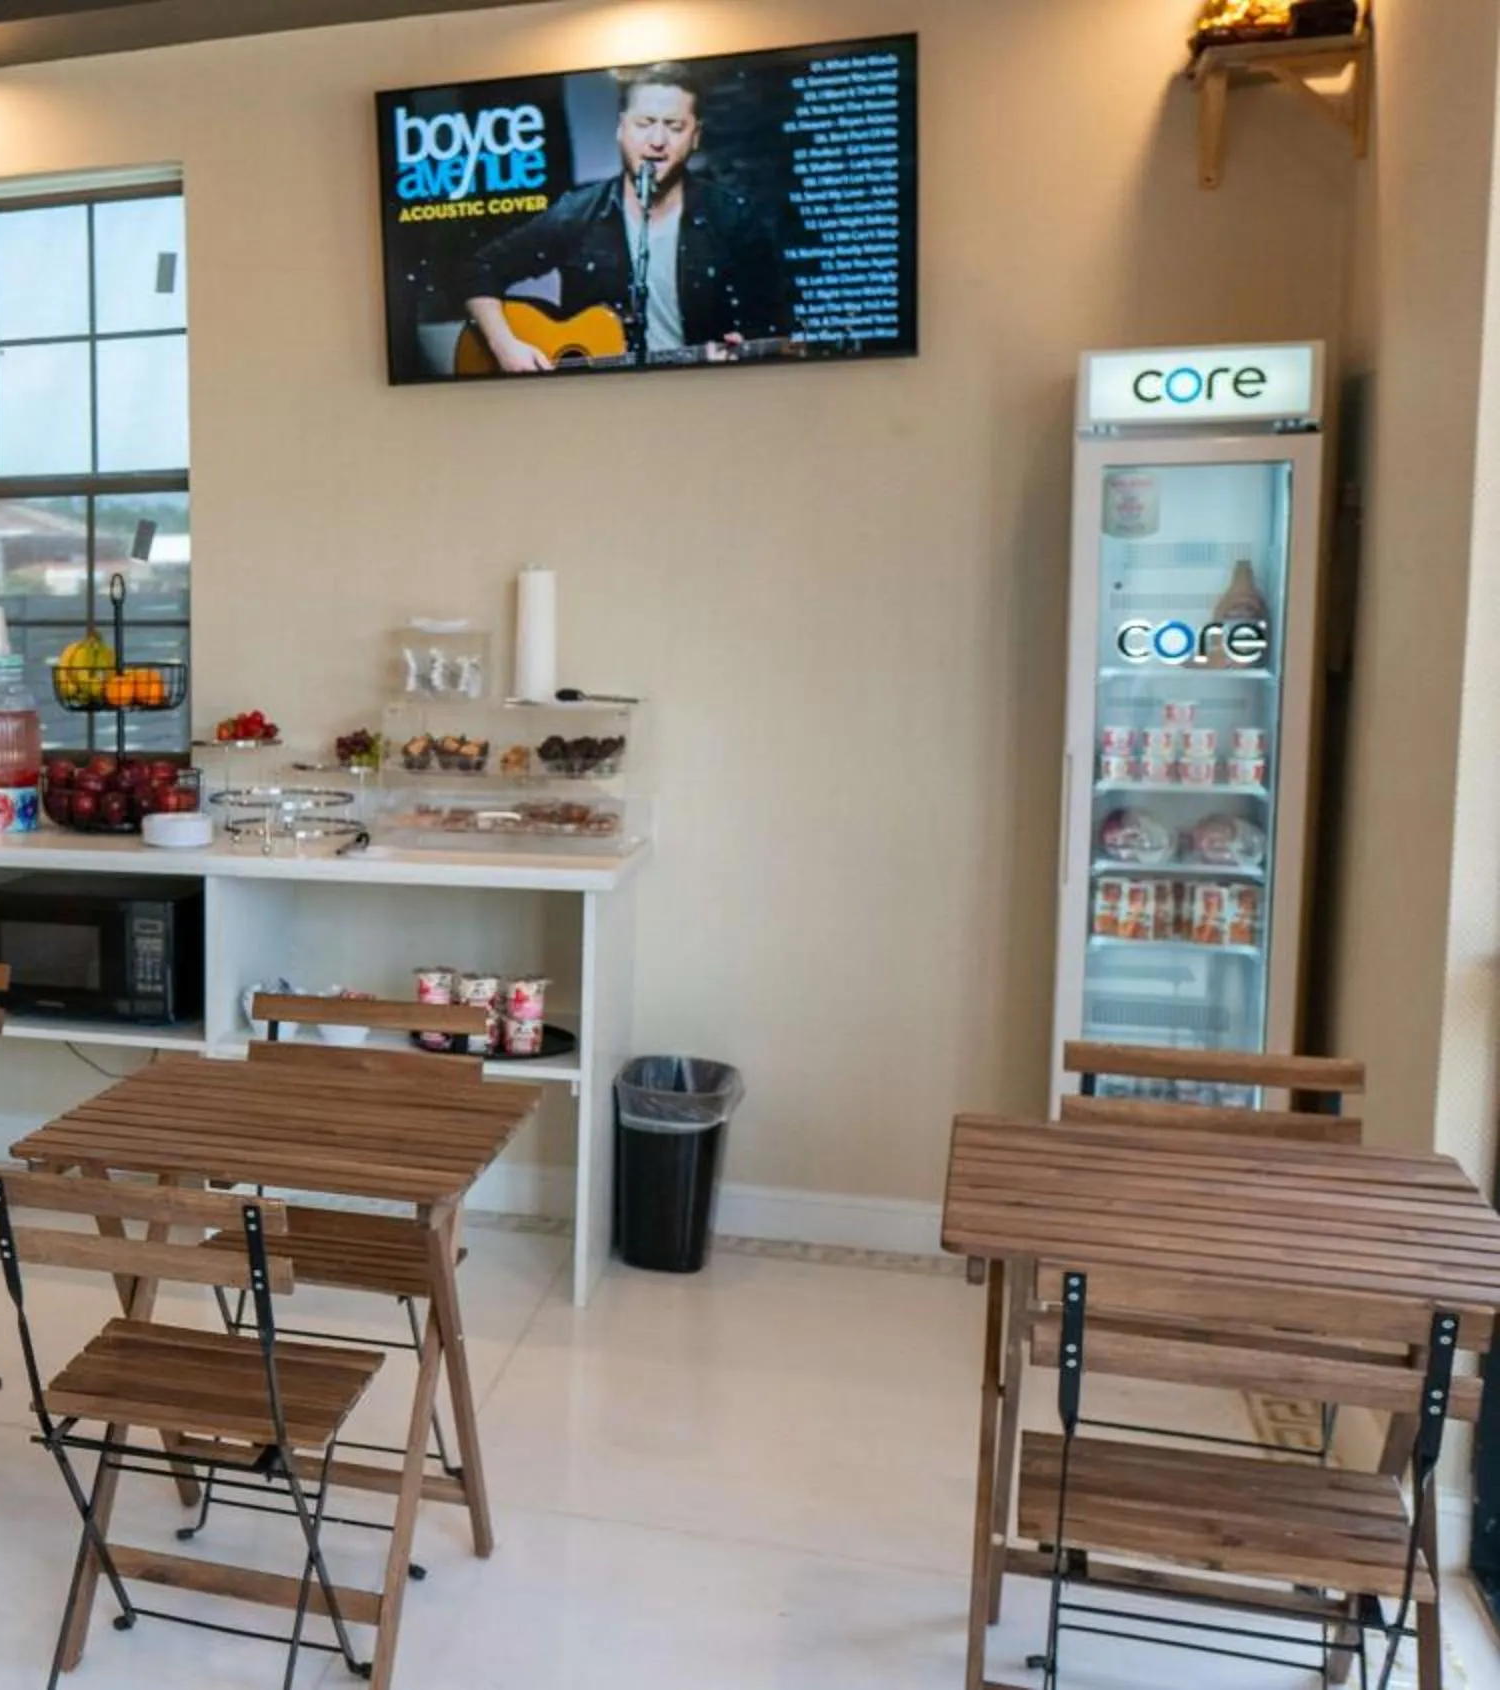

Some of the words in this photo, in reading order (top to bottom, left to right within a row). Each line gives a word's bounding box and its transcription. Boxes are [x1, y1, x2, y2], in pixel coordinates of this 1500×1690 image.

[396, 104, 546, 200] boyce
[397, 150, 547, 199] avenue
[399, 201, 485, 222] ACOUSTIC
[488, 195, 548, 214] COVER
[1133, 367, 1267, 403] core
[1117, 620, 1267, 662] core
